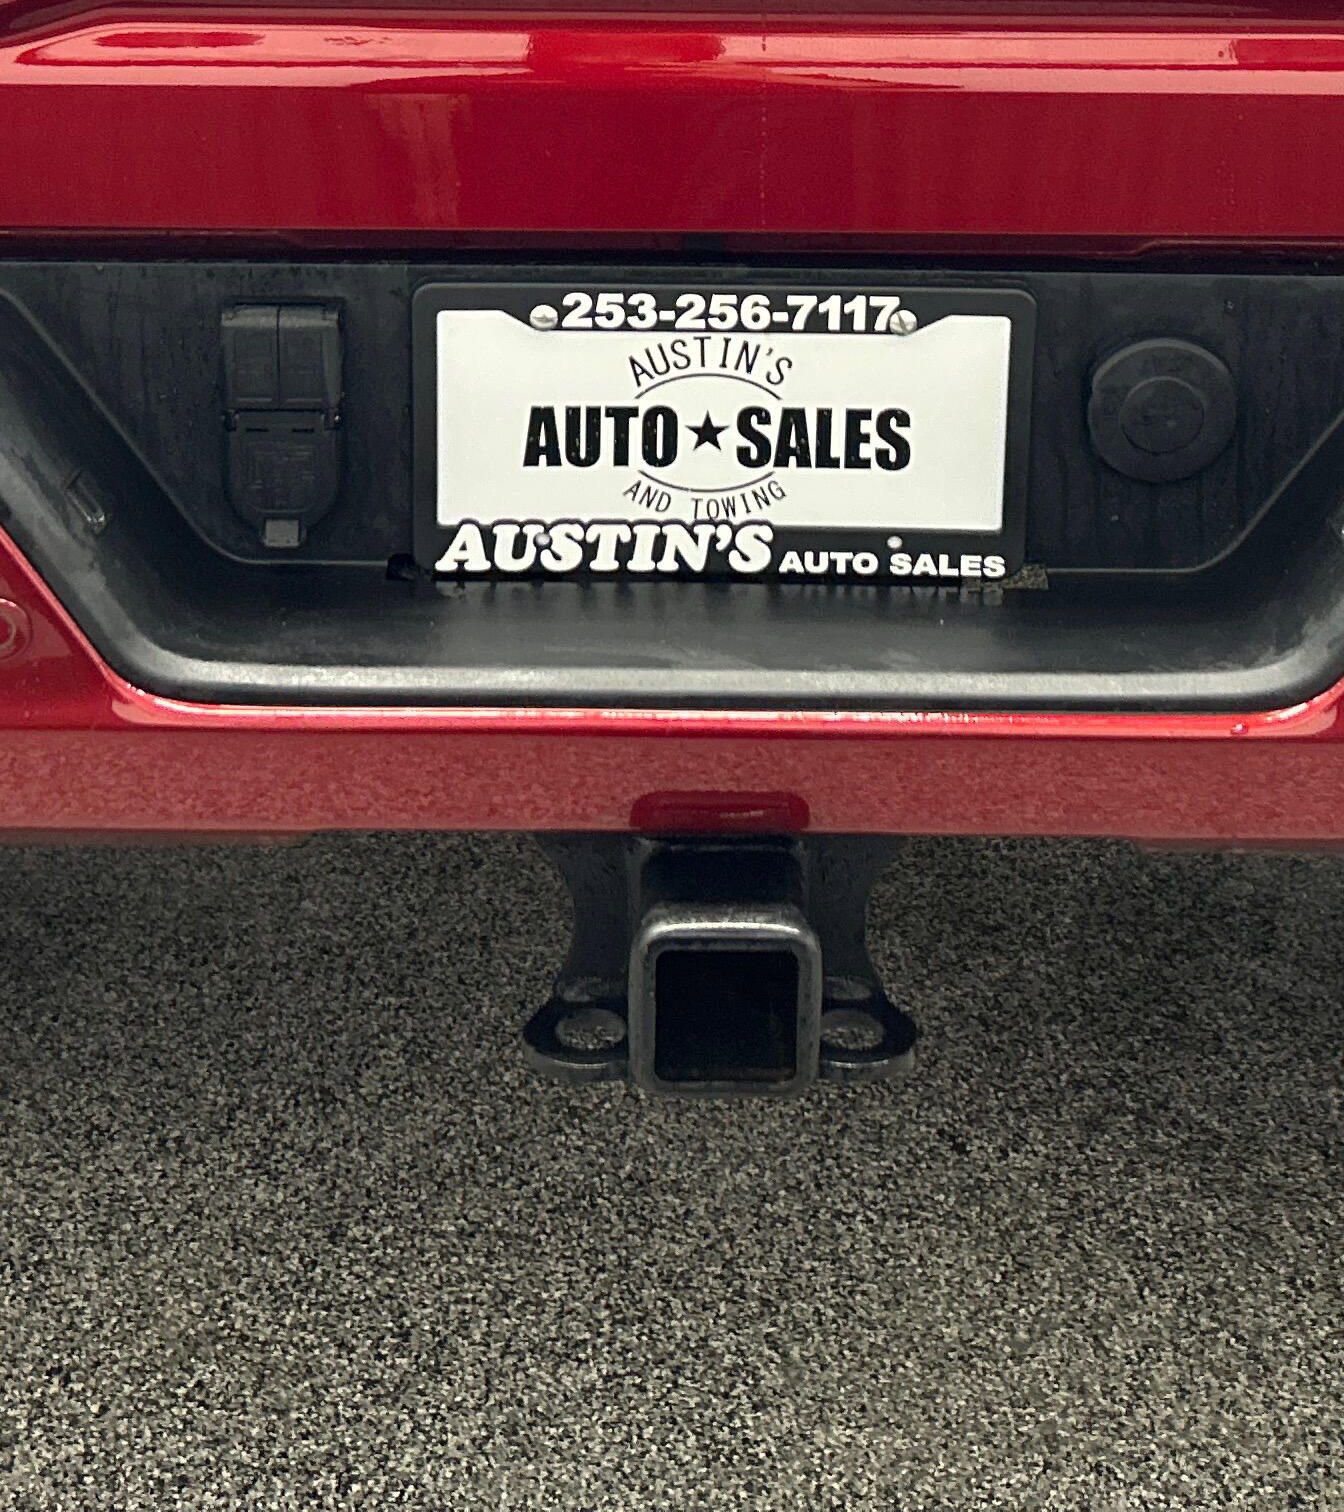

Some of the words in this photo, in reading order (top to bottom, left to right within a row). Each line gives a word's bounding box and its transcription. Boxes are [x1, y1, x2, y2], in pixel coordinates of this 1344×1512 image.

[561, 292, 900, 332] 253-256-7117
[627, 335, 793, 388] AUSTIN'S
[523, 405, 679, 469] AUTO
[736, 406, 912, 471] SALES
[622, 478, 672, 514] AND
[691, 478, 787, 522] TOWING
[435, 520, 775, 575] AUSTIN'S
[778, 551, 879, 576] AUTO
[889, 552, 1007, 578] SALES
